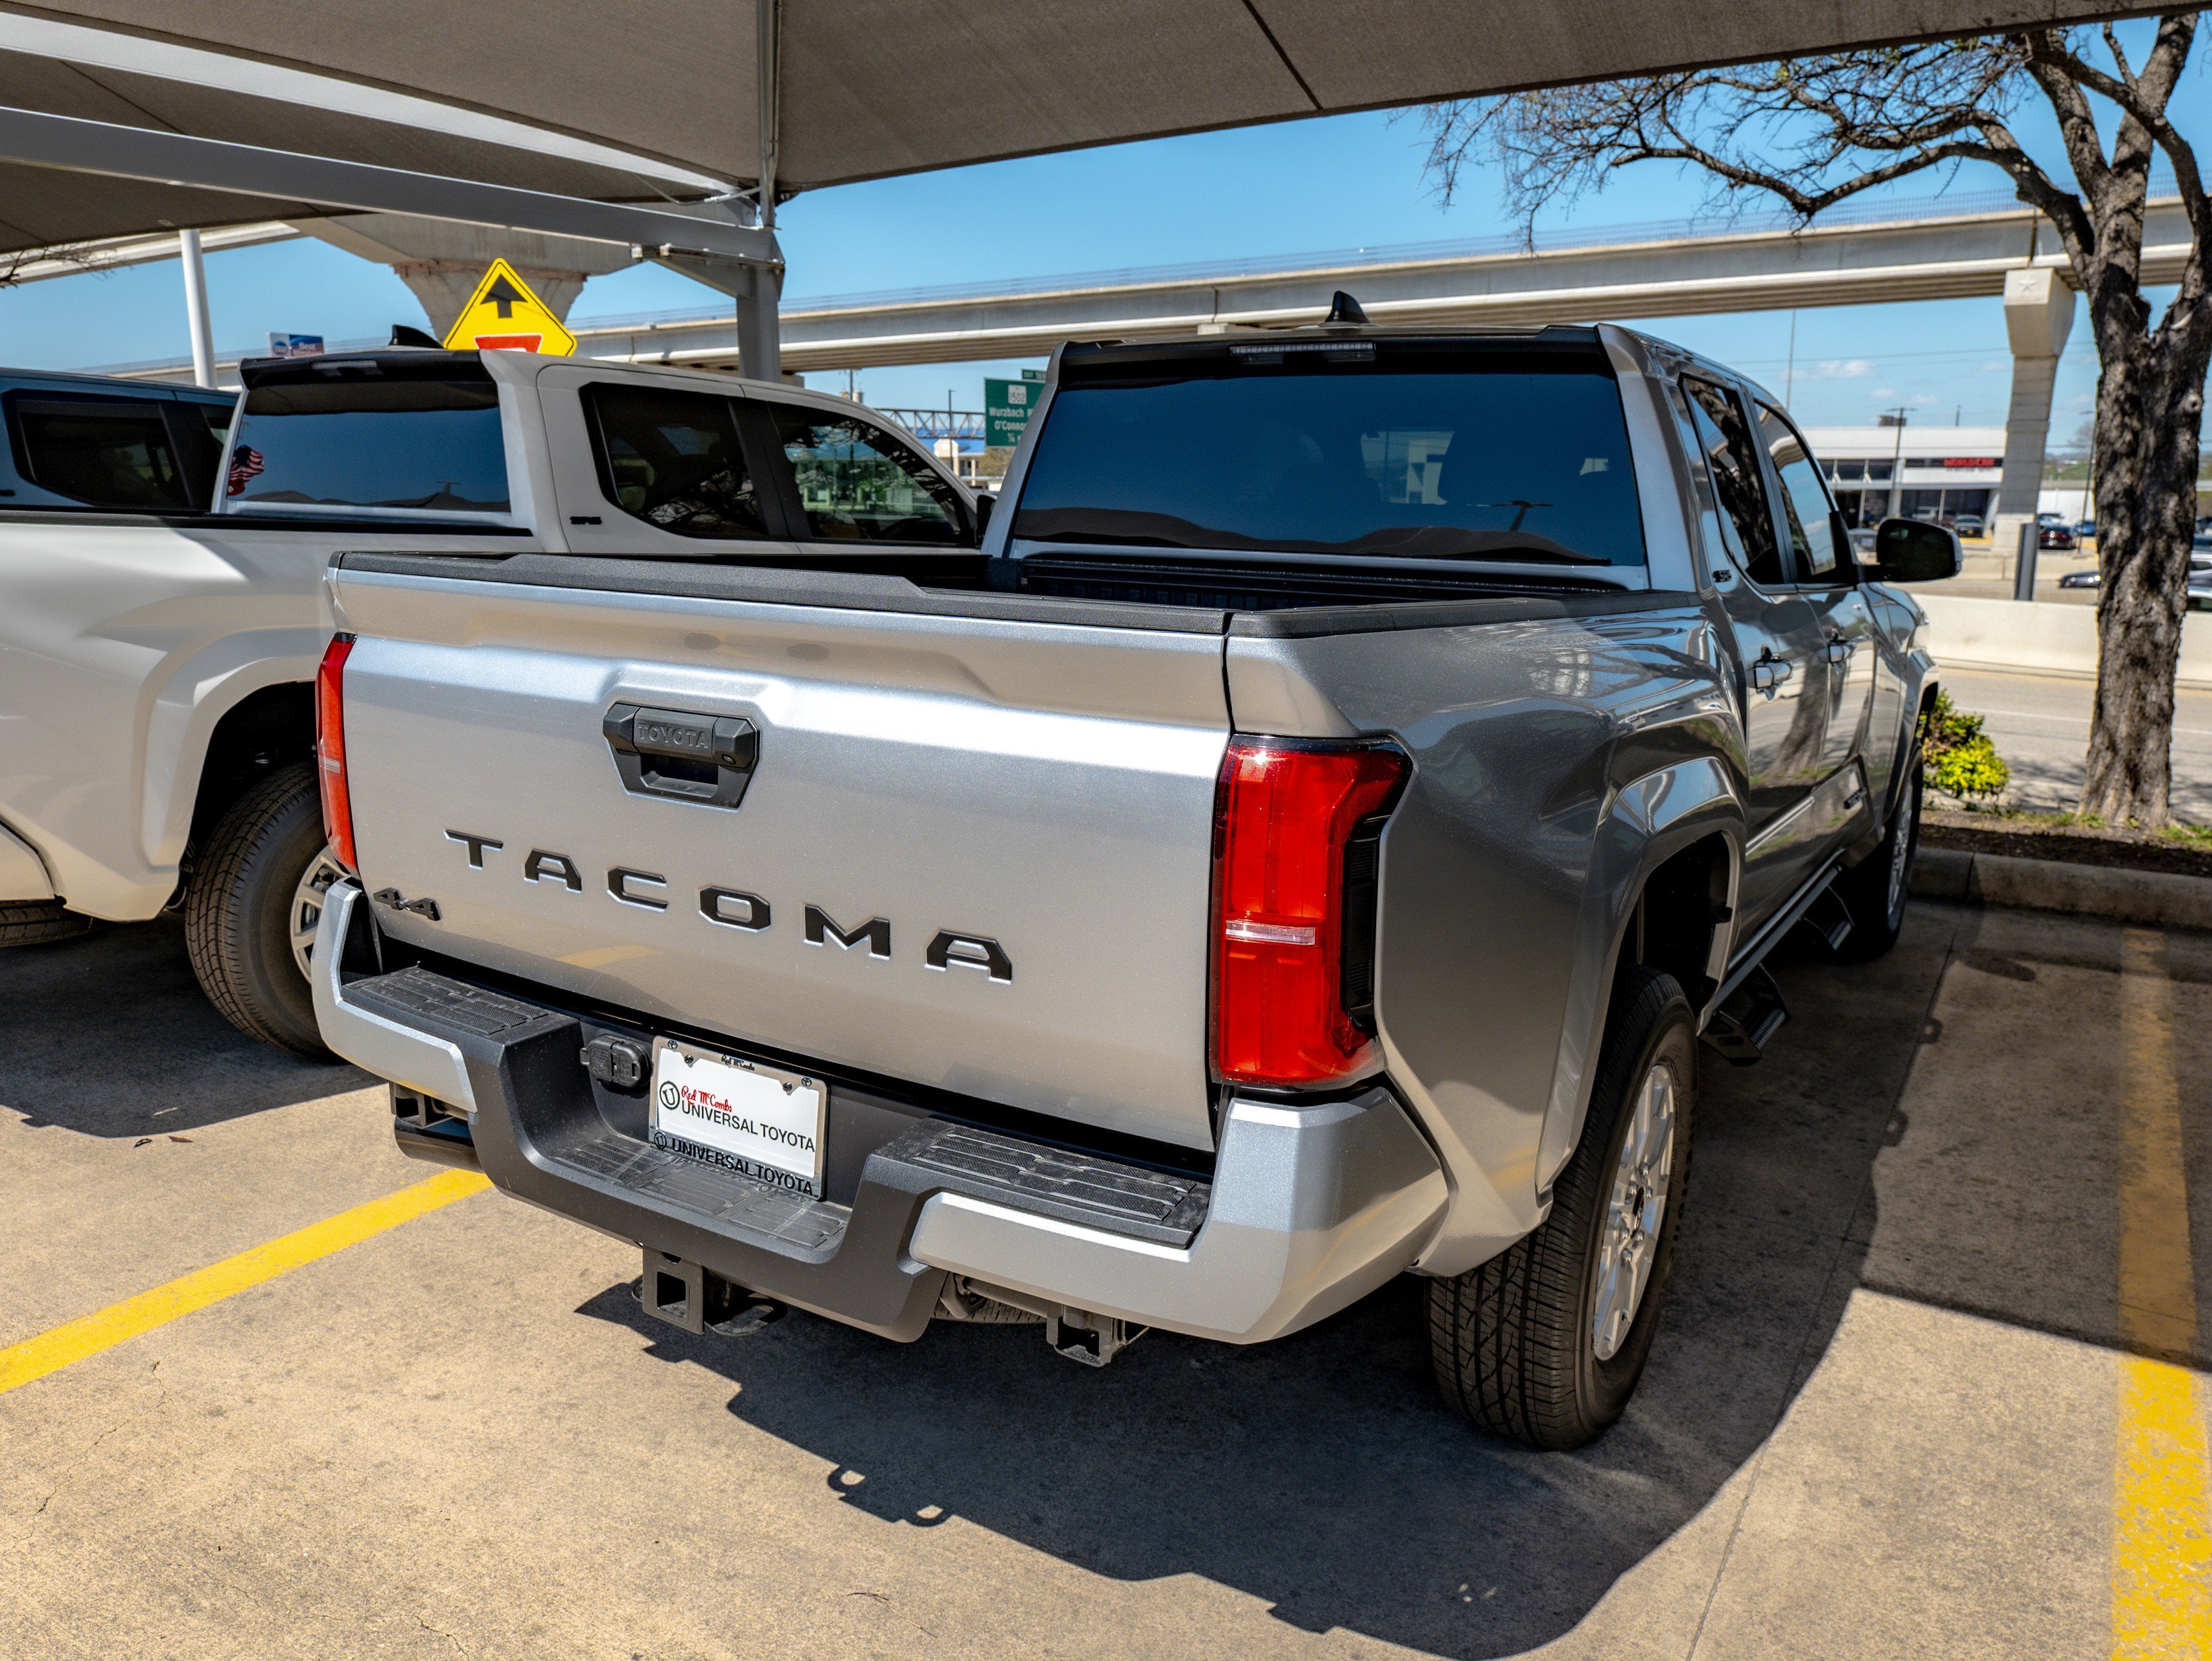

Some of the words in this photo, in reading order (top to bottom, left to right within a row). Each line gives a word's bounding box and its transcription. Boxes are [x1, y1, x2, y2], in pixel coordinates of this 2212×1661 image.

[988, 407, 1024, 418] Wurzbach
[638, 723, 708, 748] TOYOTA
[444, 829, 1013, 985] TACOMA
[681, 1085, 696, 1106] Red
[681, 1100, 758, 1136] UNIVERSAL
[760, 1123, 816, 1152] TOYOTA
[671, 1138, 755, 1177] UNIVERSAL
[755, 1163, 813, 1197] TOYOTA
